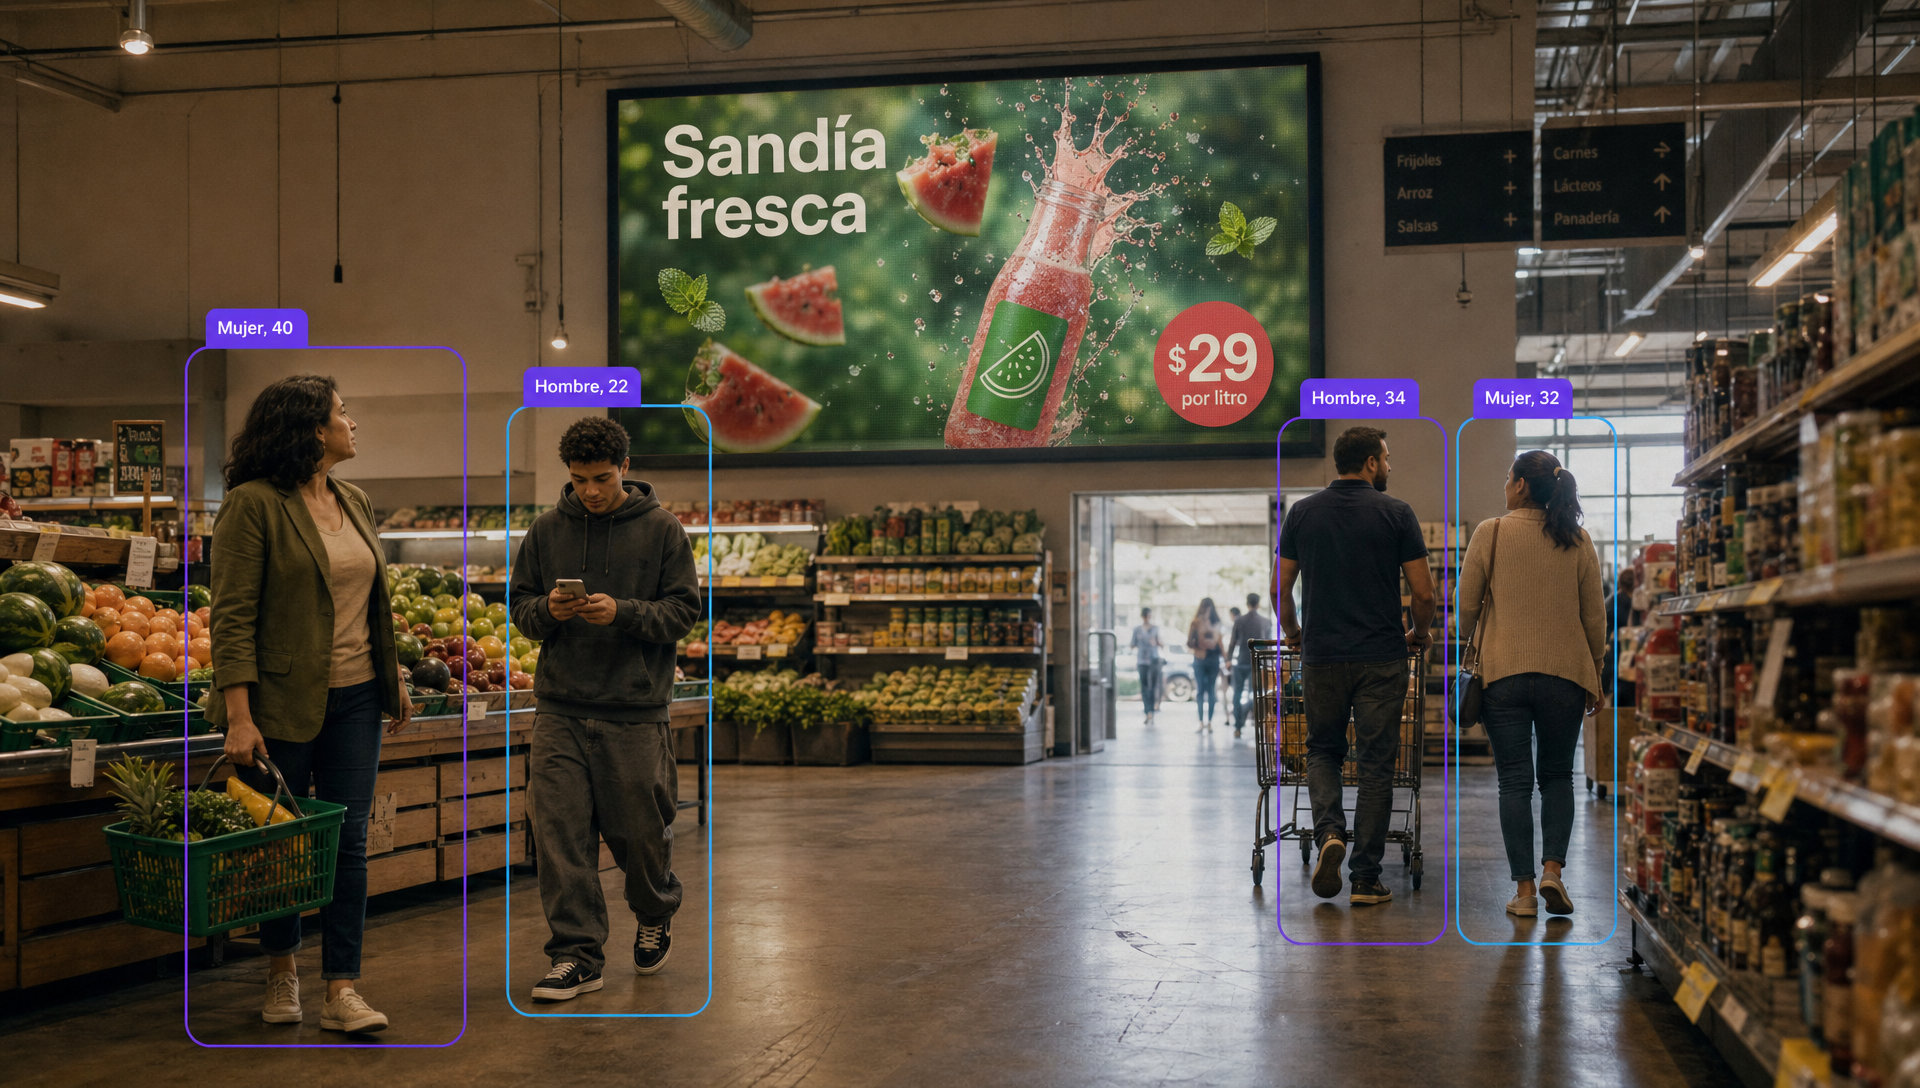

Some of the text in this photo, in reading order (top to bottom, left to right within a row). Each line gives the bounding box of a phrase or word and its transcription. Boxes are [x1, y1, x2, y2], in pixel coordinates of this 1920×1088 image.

[662, 114, 887, 179] Sandía
[1553, 146, 1599, 161] Carnes
[1397, 153, 1442, 170] Frijoles
[1397, 186, 1434, 200] Arroz
[1554, 178, 1603, 193] Lácteos
[662, 184, 867, 240] fresca
[1554, 210, 1620, 226] Panadería
[1397, 218, 1439, 234] Salsas
[1168, 332, 1258, 383] $29
[1182, 389, 1248, 411] por litro
